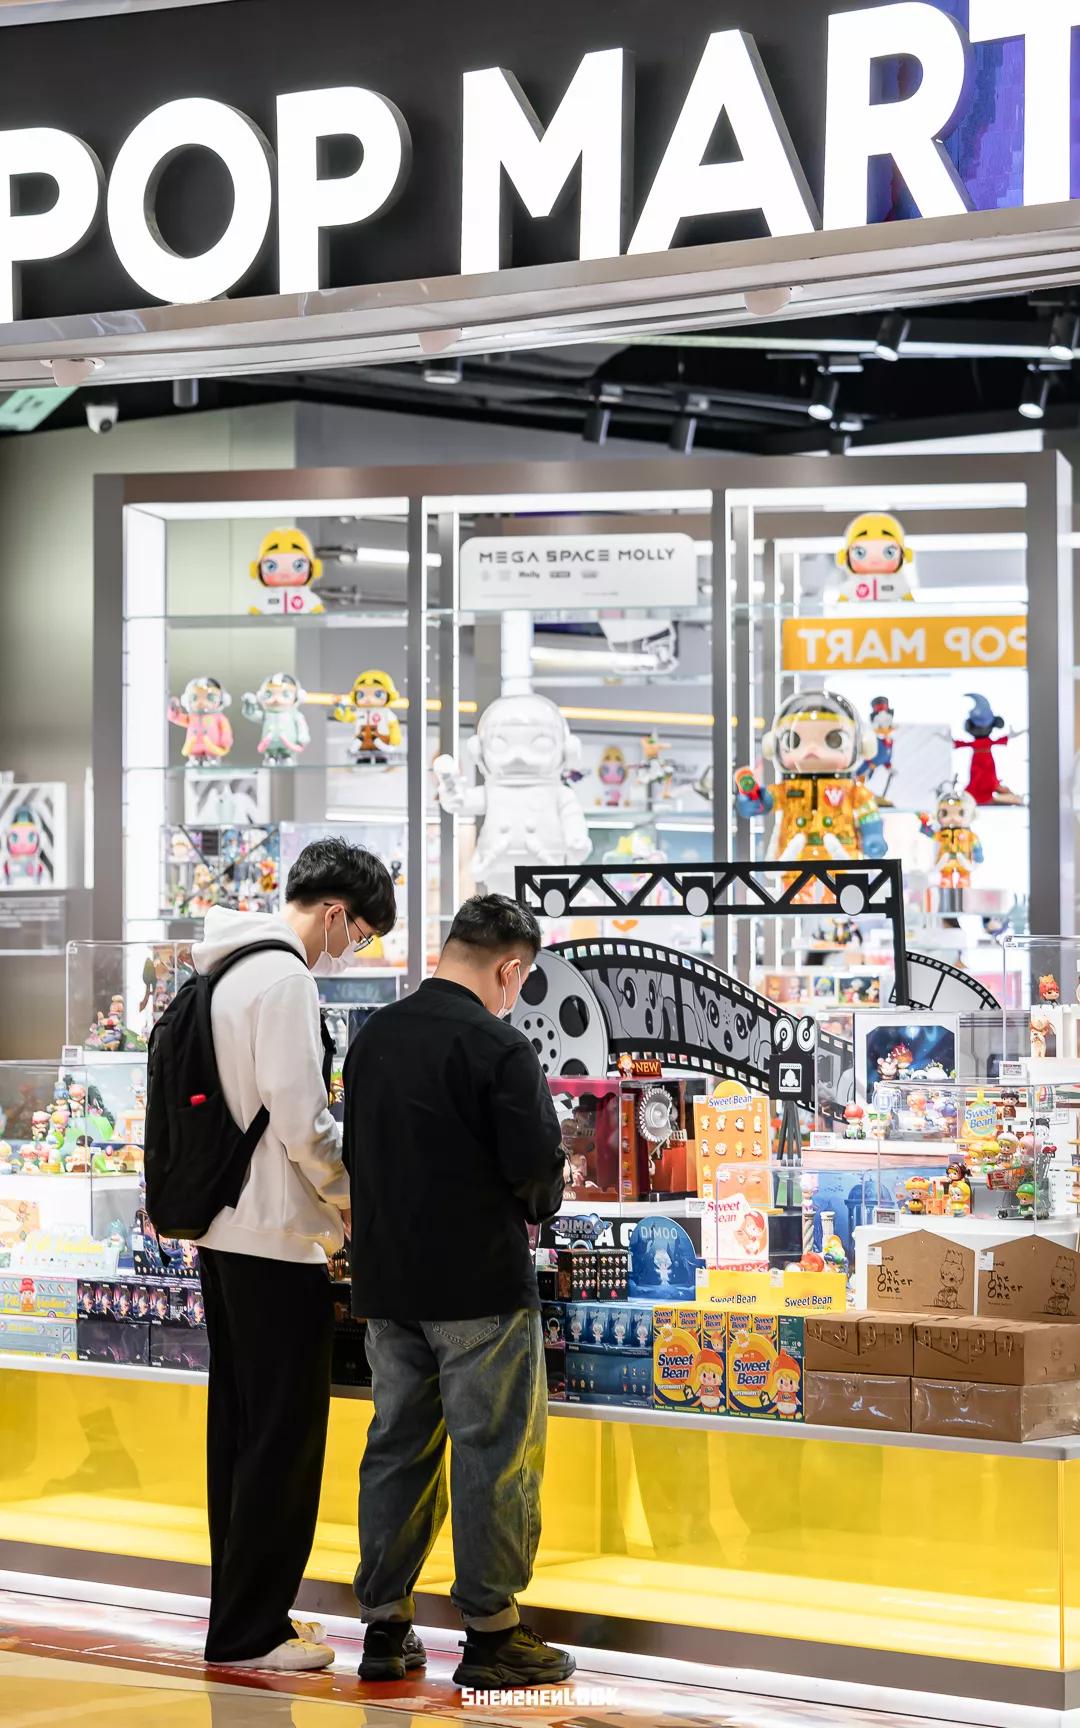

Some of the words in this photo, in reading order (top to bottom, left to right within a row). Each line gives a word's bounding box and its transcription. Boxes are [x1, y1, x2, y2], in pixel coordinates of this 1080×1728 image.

[0, 86, 412, 324] POP
[462, 0, 1080, 275] MART
[479, 551, 540, 563] MEGA
[546, 549, 610, 562] SPACE
[618, 548, 675, 561] MOLLY
[635, 1061, 659, 1073] NEW
[709, 1096, 733, 1107] Sweet
[733, 1094, 752, 1104] Bean
[965, 1104, 996, 1120] Sweet
[970, 1117, 992, 1129] Bean
[640, 1225, 678, 1240] DIMOO
[877, 1264, 900, 1276] The
[988, 1270, 1010, 1282] The
[877, 1273, 913, 1286] Other
[988, 1280, 1024, 1292] Other
[877, 1282, 901, 1293] One
[988, 1288, 1011, 1300] One
[736, 1294, 757, 1304] Bean
[785, 1297, 811, 1308] Sweet
[811, 1295, 832, 1305] Bean
[657, 1353, 694, 1367] Sweet
[733, 1359, 771, 1372] Sweet
[661, 1366, 690, 1379] Bean
[737, 1372, 766, 1386] Bean
